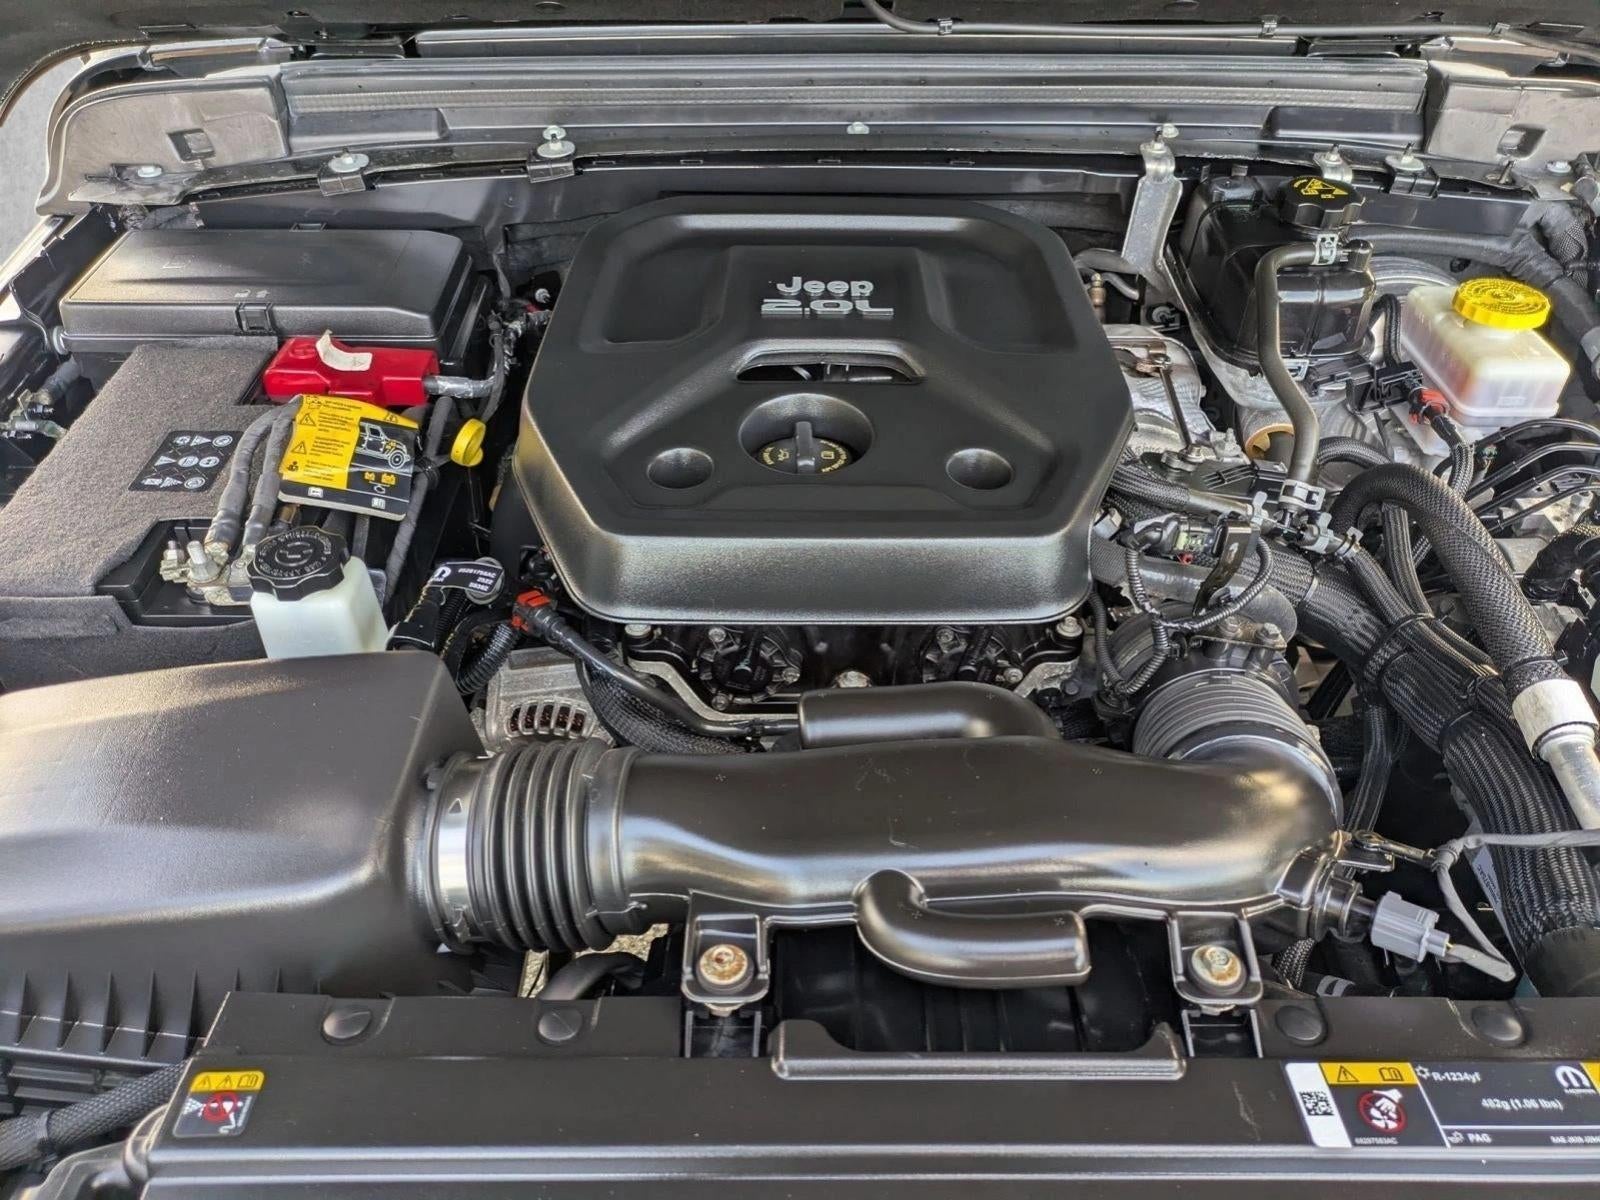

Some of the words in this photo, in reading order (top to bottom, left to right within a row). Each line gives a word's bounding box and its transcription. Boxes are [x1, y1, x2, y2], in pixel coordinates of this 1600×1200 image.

[776, 276, 874, 297] Jeep
[761, 299, 894, 316] 2.0L
[1432, 1071, 1482, 1084] R-1234yf
